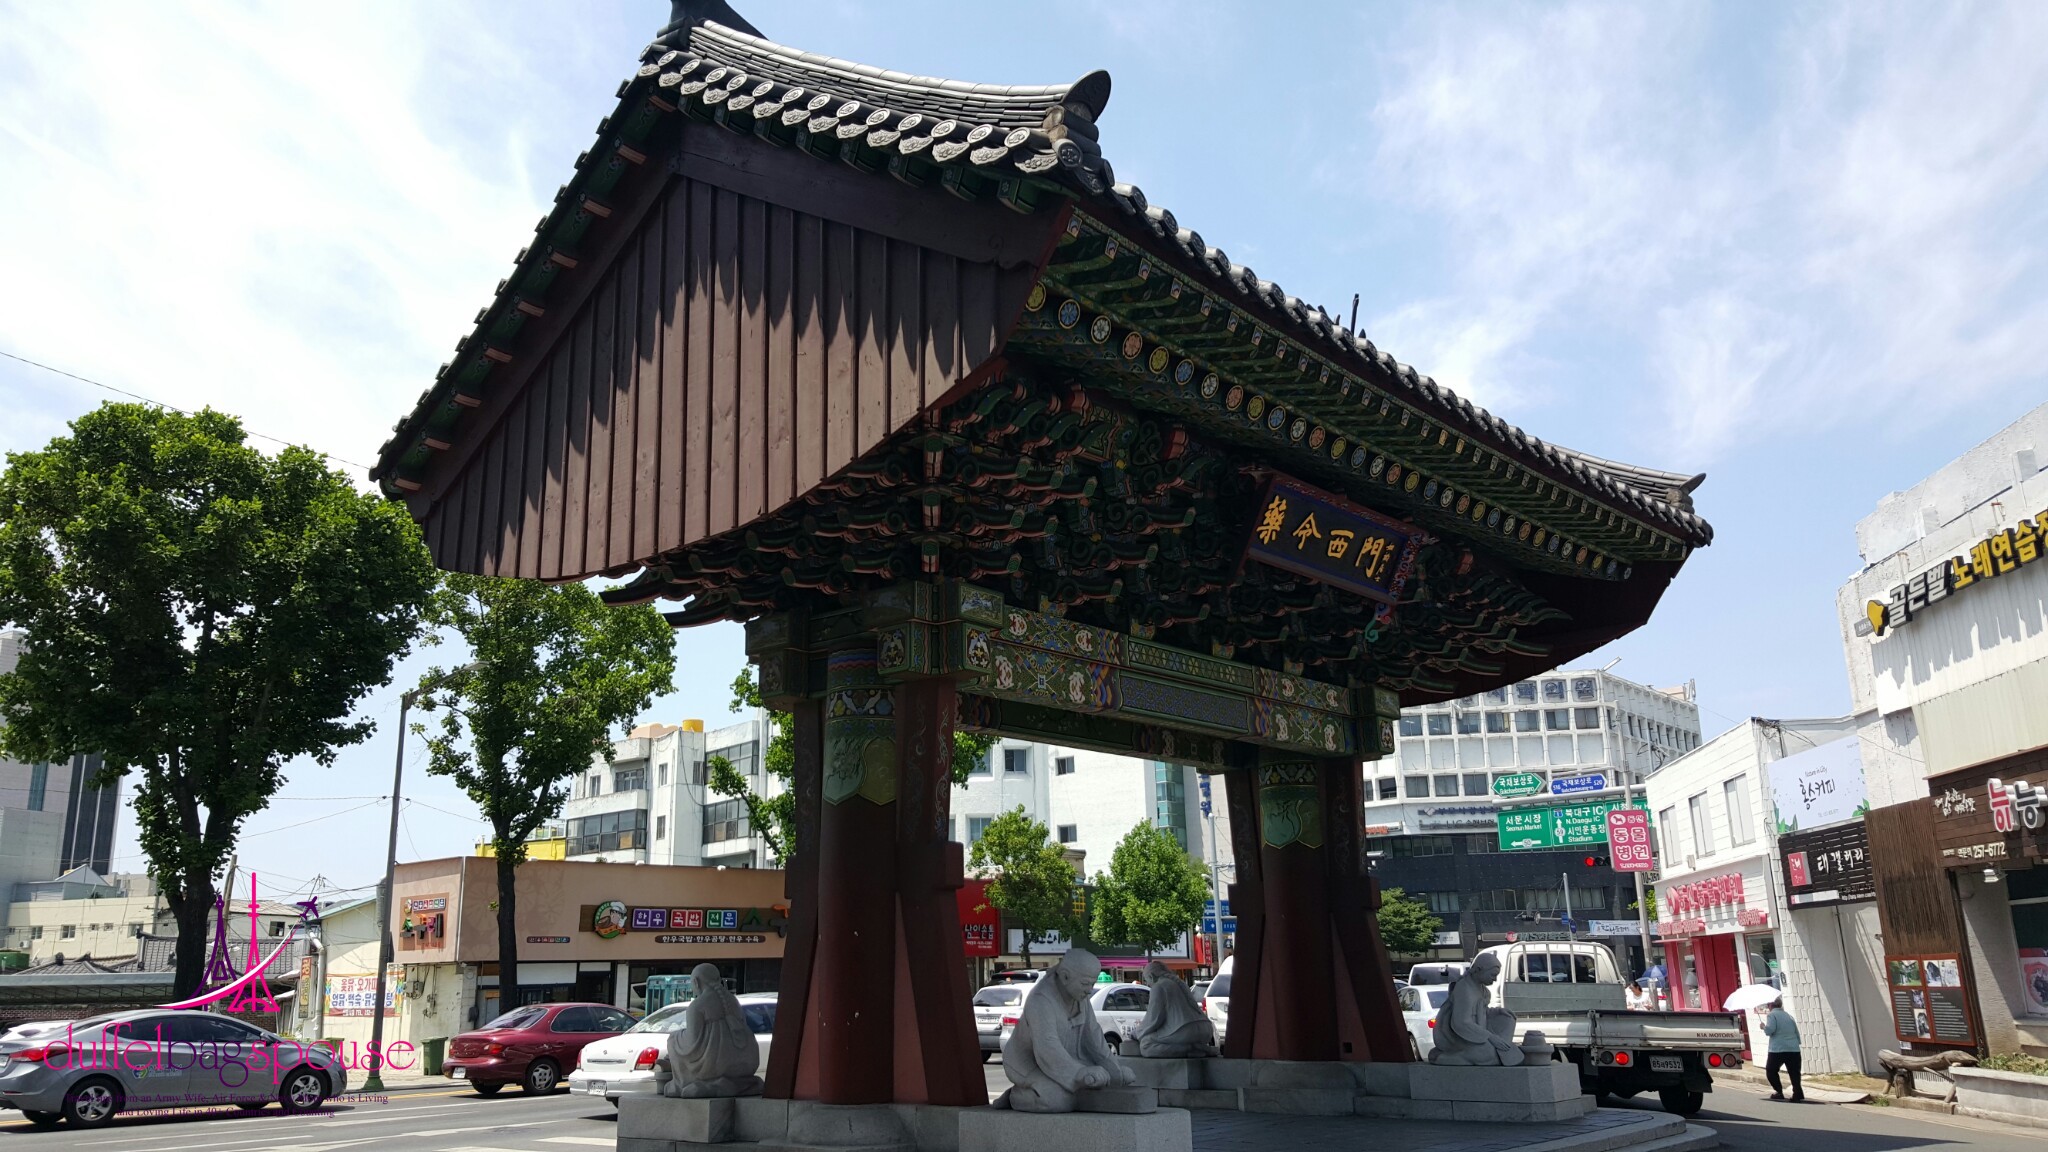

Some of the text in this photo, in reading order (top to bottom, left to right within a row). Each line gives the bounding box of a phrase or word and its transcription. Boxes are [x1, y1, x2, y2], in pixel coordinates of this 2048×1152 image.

[1888, 562, 1948, 628] 골든벨
[1505, 813, 1541, 825] 서문 시장
[1565, 806, 1604, 818] 북대구 IC
[1614, 827, 1646, 843] 동물
[1615, 844, 1650, 860] 병원
[636, 911, 663, 926] 한우
[673, 911, 700, 926] 국밥
